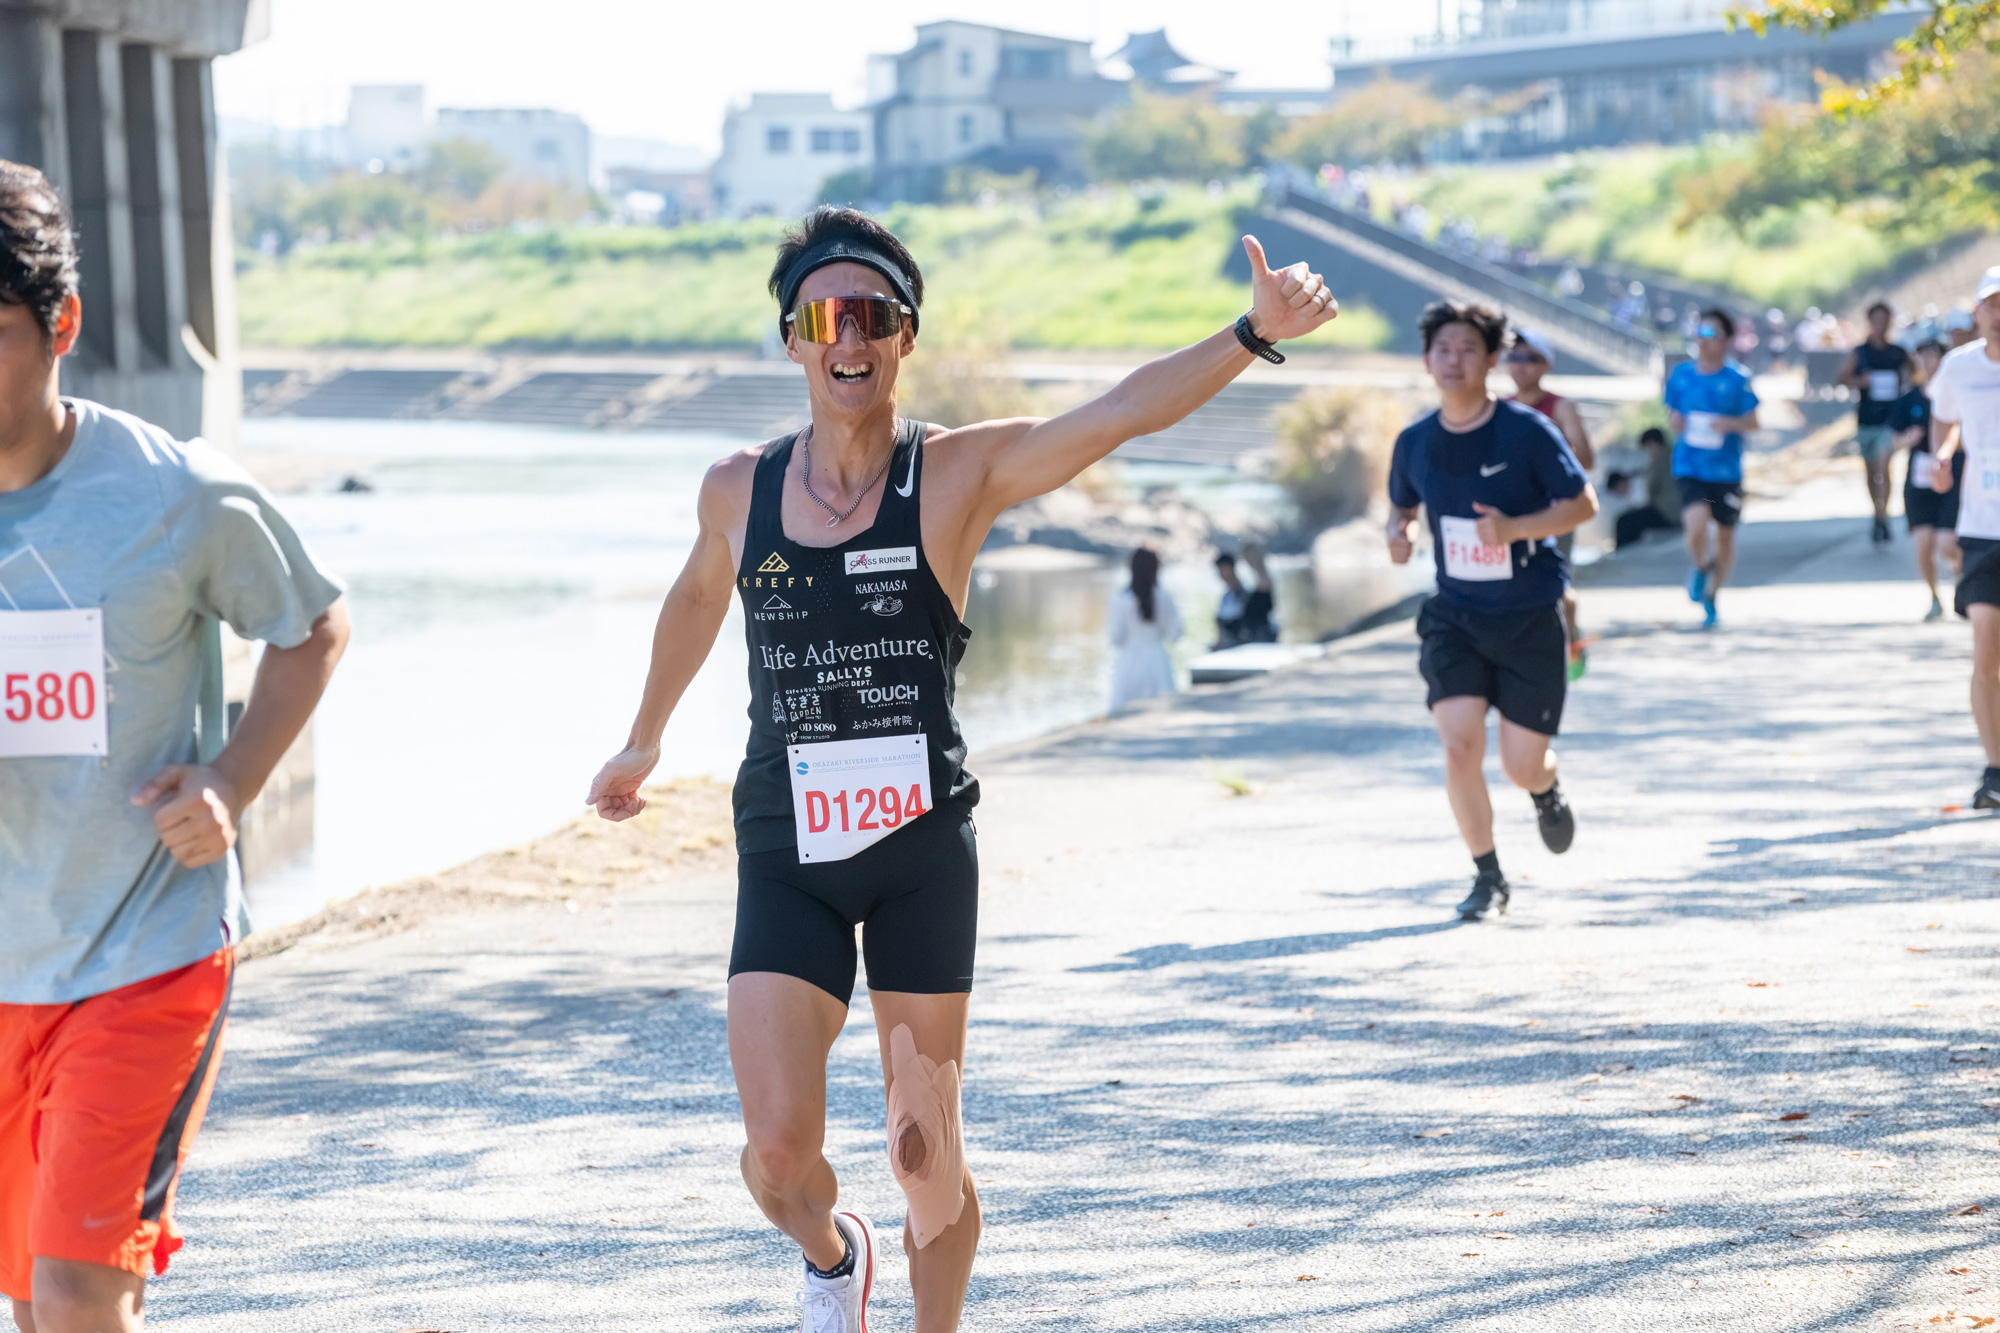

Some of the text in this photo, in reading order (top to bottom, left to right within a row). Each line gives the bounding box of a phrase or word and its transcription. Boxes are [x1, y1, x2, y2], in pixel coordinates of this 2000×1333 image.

[879, 555, 911, 565] RUNNER
[1449, 541, 1506, 567] F1489
[742, 576, 814, 588] KREFY
[855, 579, 908, 595] NAKAMASA
[760, 644, 796, 670] life
[817, 666, 872, 684] SALLYS
[817, 679, 873, 692] RUNNING DEPT.
[5, 671, 95, 723] 580
[786, 693, 820, 710] なぎさ
[857, 684, 918, 704] TOUCH
[789, 706, 822, 722] GARDEN
[852, 714, 913, 730] ふかみ接骨院
[813, 723, 837, 732] SOSO
[812, 753, 921, 768] OKAZAKI RIVERSIDE MARATHON
[805, 783, 927, 833] D1294
